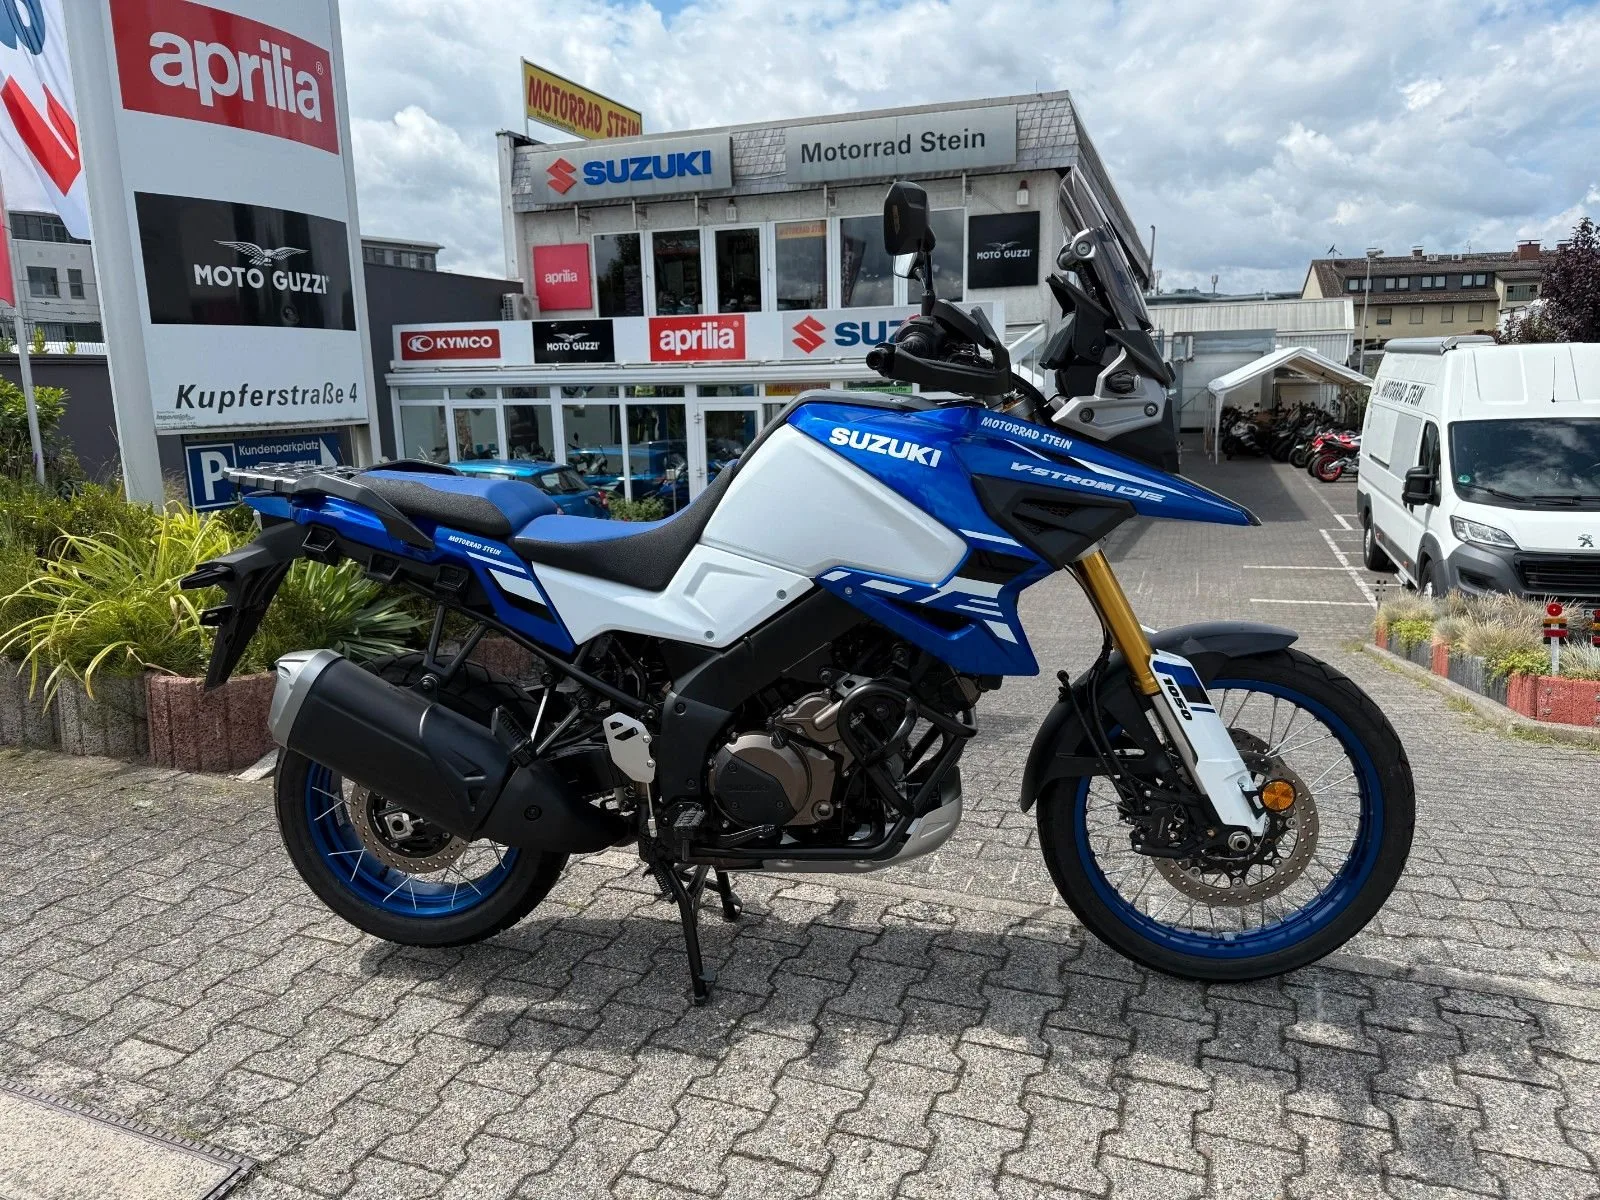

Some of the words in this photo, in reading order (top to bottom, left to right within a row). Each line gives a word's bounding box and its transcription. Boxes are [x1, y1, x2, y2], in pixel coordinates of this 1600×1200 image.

[150, 31, 323, 123] aprilia
[528, 75, 602, 133] MOTORRAD
[606, 110, 640, 138] STEIN
[801, 133, 911, 164] Motorrad
[920, 128, 986, 153] Stein
[583, 150, 712, 186] SUZUKI
[976, 249, 1001, 260] MOTO
[1003, 248, 1031, 259] GUZZI
[194, 264, 264, 288] MOTO
[272, 270, 328, 295] GUZZI
[544, 269, 578, 285] aprilia
[436, 335, 493, 349] KYMCO
[546, 341, 570, 351] MOTO
[572, 341, 599, 351] GUZZI
[659, 321, 735, 355] aprilia
[175, 382, 343, 414] Kupferstraße
[349, 382, 358, 403] 4
[1404, 384, 1426, 407] STEIN
[829, 427, 942, 468] SUZUKI
[980, 416, 1039, 440] MOTORRAD
[1041, 433, 1073, 450] STEIN
[200, 451, 228, 501] P
[239, 440, 319, 456] Kundenparkplatz
[1010, 462, 1116, 492] V-STROM
[1115, 485, 1167, 503] DE
[447, 535, 482, 550] MOTORRAD
[482, 545, 502, 556] STEIN
[1162, 677, 1193, 721] 1050
